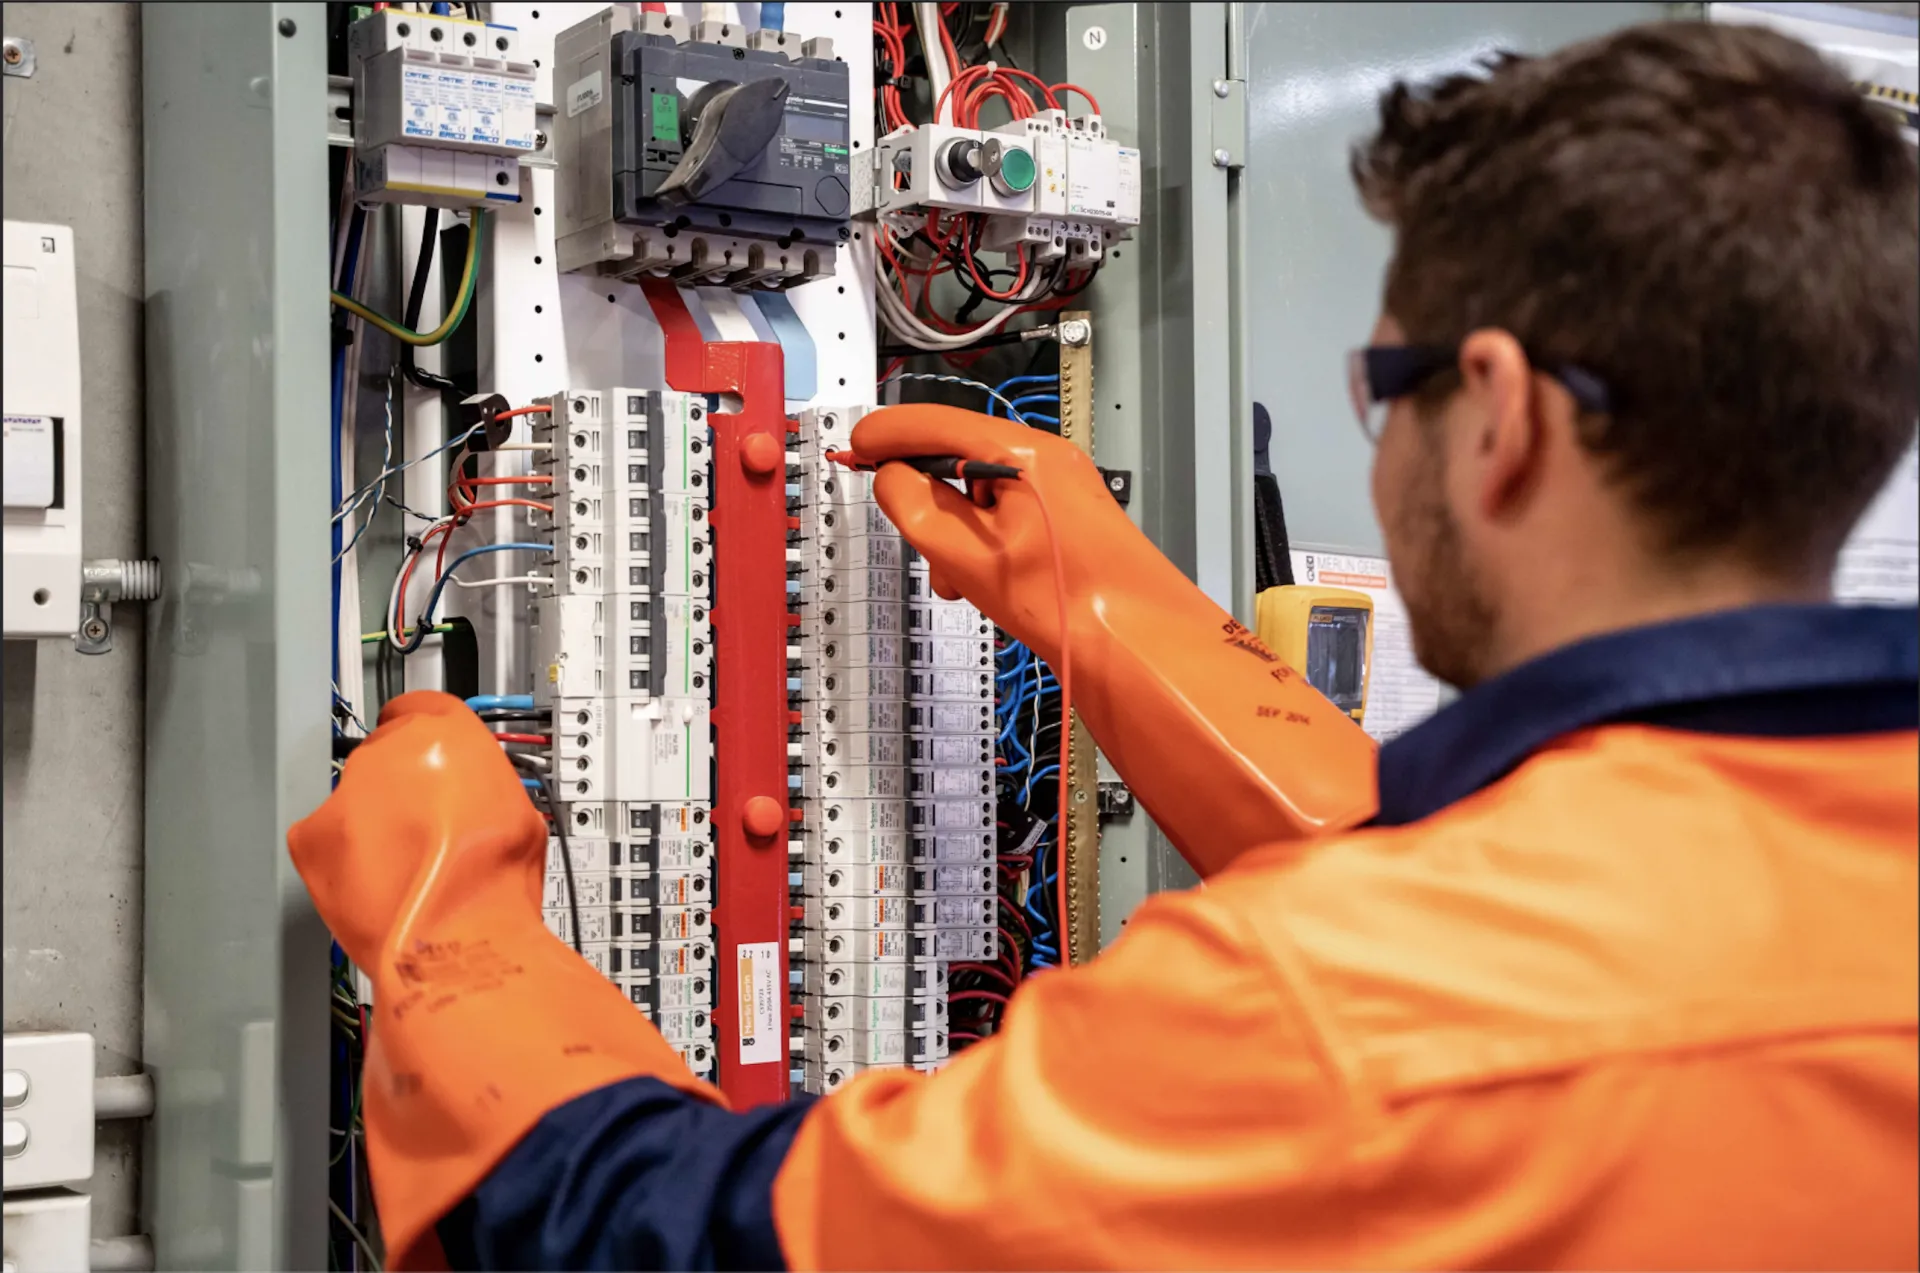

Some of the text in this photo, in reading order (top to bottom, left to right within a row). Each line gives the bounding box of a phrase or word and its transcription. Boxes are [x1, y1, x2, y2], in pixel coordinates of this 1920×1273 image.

[1089, 31, 1102, 44] N
[405, 127, 433, 136] ERICO
[438, 131, 466, 140] ERICO
[472, 134, 499, 143] ERICO
[505, 139, 532, 148] ERICO
[1317, 556, 1355, 572] MERLIN
[743, 974, 753, 1034] Merlin Gerin
